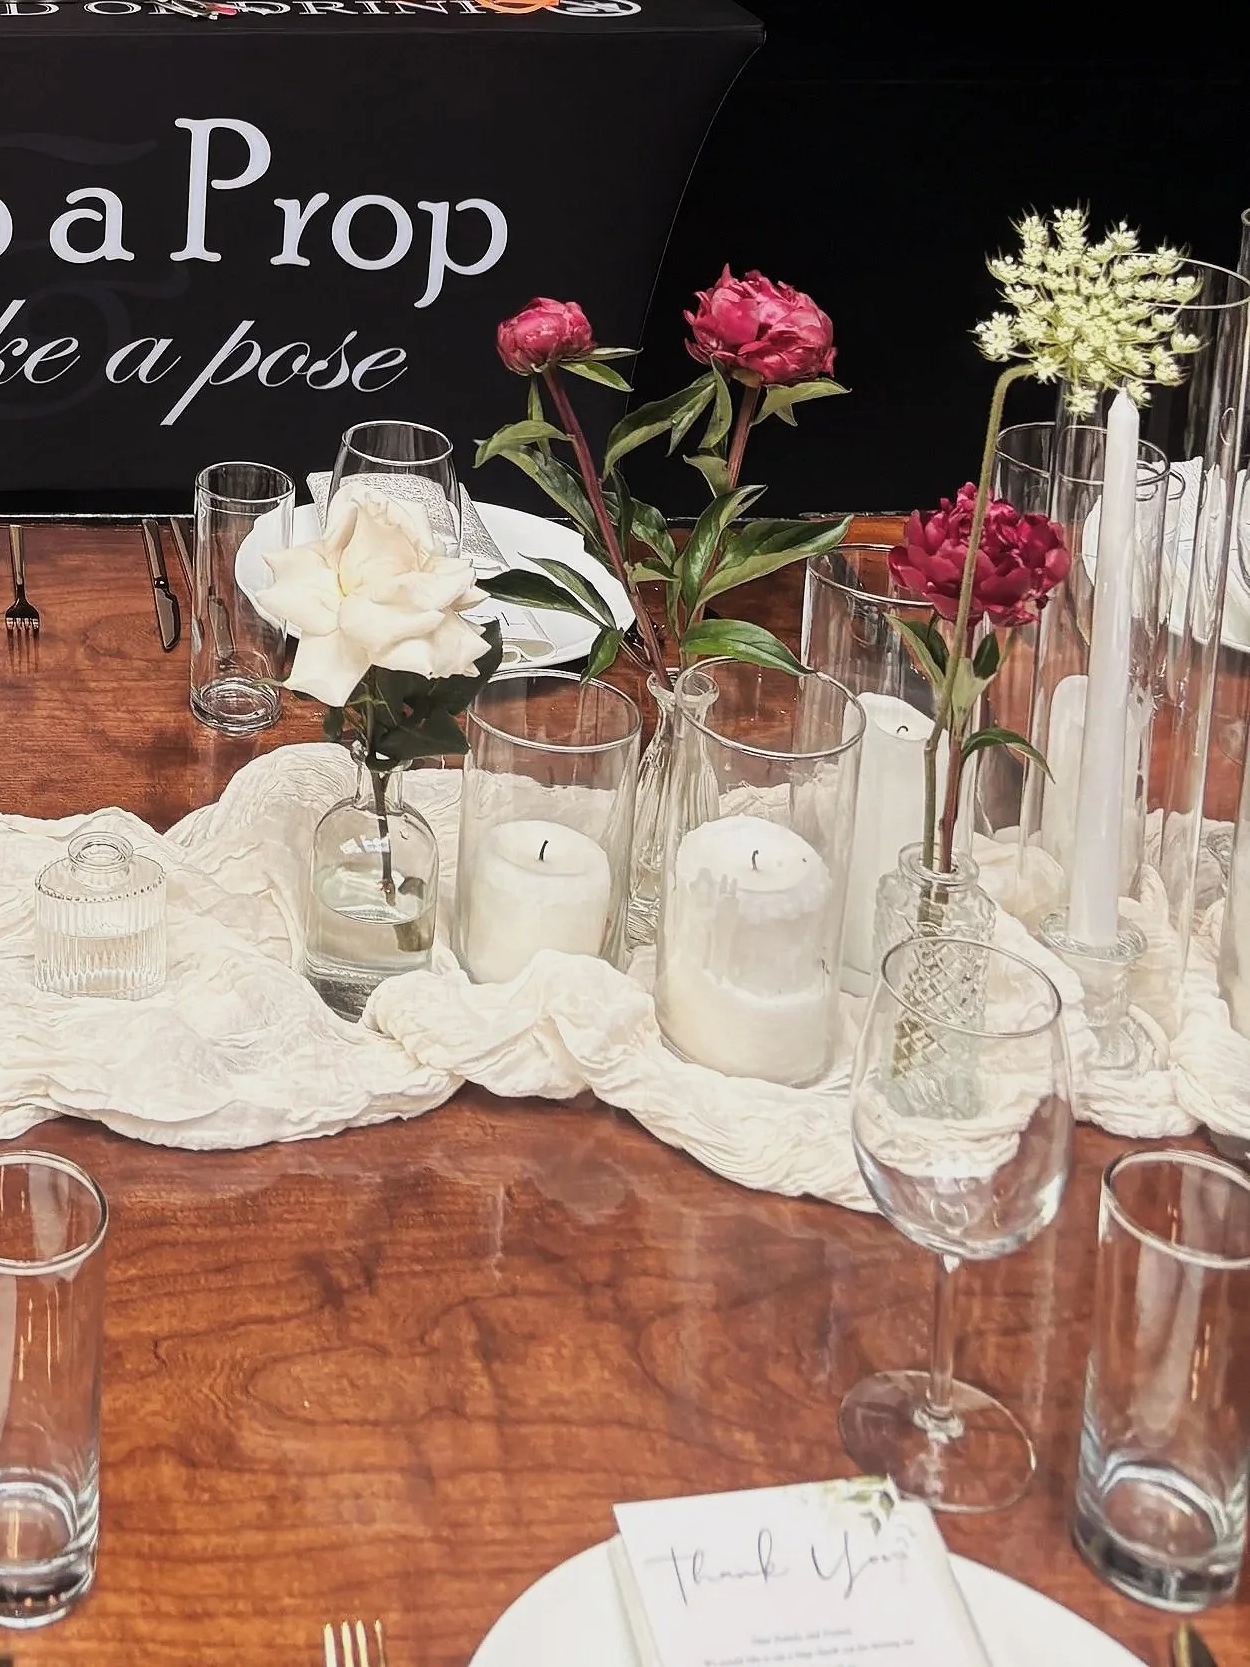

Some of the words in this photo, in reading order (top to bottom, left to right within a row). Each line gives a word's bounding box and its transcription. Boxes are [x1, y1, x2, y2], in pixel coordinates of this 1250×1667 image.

[50, 184, 136, 265] a
[168, 116, 509, 309] Prop
[105, 336, 181, 388] a
[160, 318, 409, 426] pose
[643, 1527, 791, 1607] Thank
